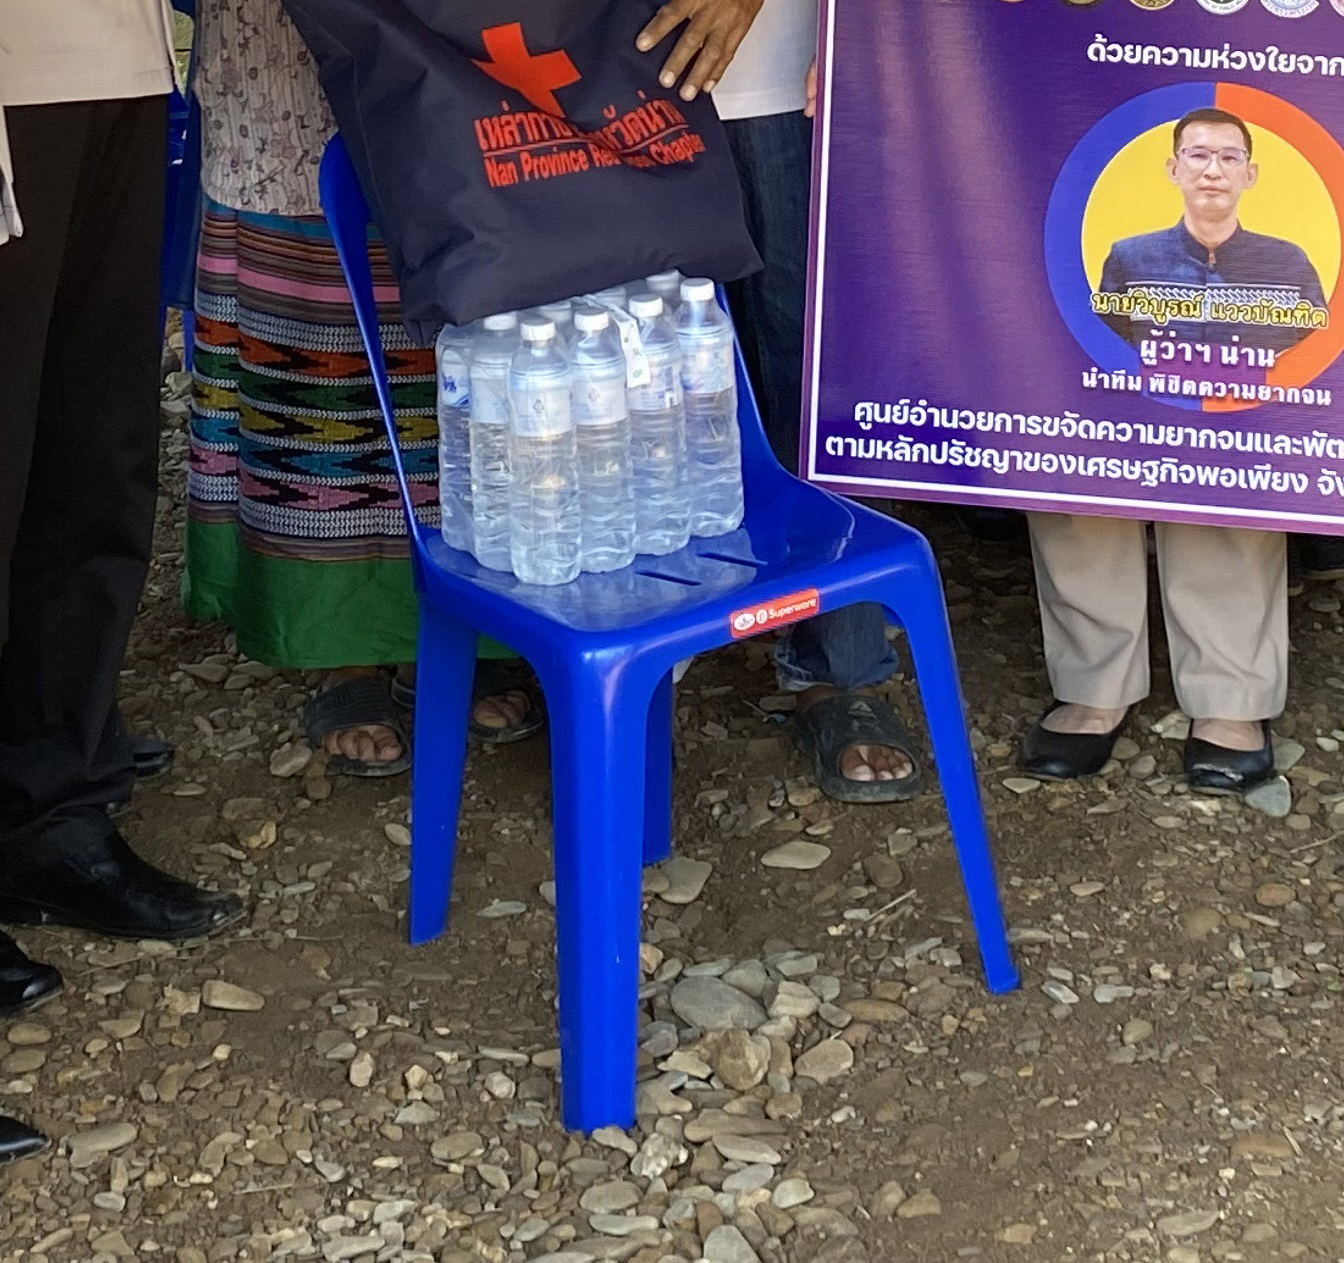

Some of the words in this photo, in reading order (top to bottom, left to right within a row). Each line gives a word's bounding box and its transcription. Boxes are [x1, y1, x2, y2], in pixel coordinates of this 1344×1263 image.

[484, 158, 518, 187] Nan
[519, 146, 590, 182] Province
[1140, 329, 1211, 365] ผู้ว่าฯ
[1220, 335, 1275, 368] น่าน
[1082, 367, 1142, 391] นำทีม
[1149, 373, 1332, 406] พิชิตความยากจน
[825, 434, 1308, 494] ตามหลักปรัชญาของเศรษฐกิจพอเพียง
